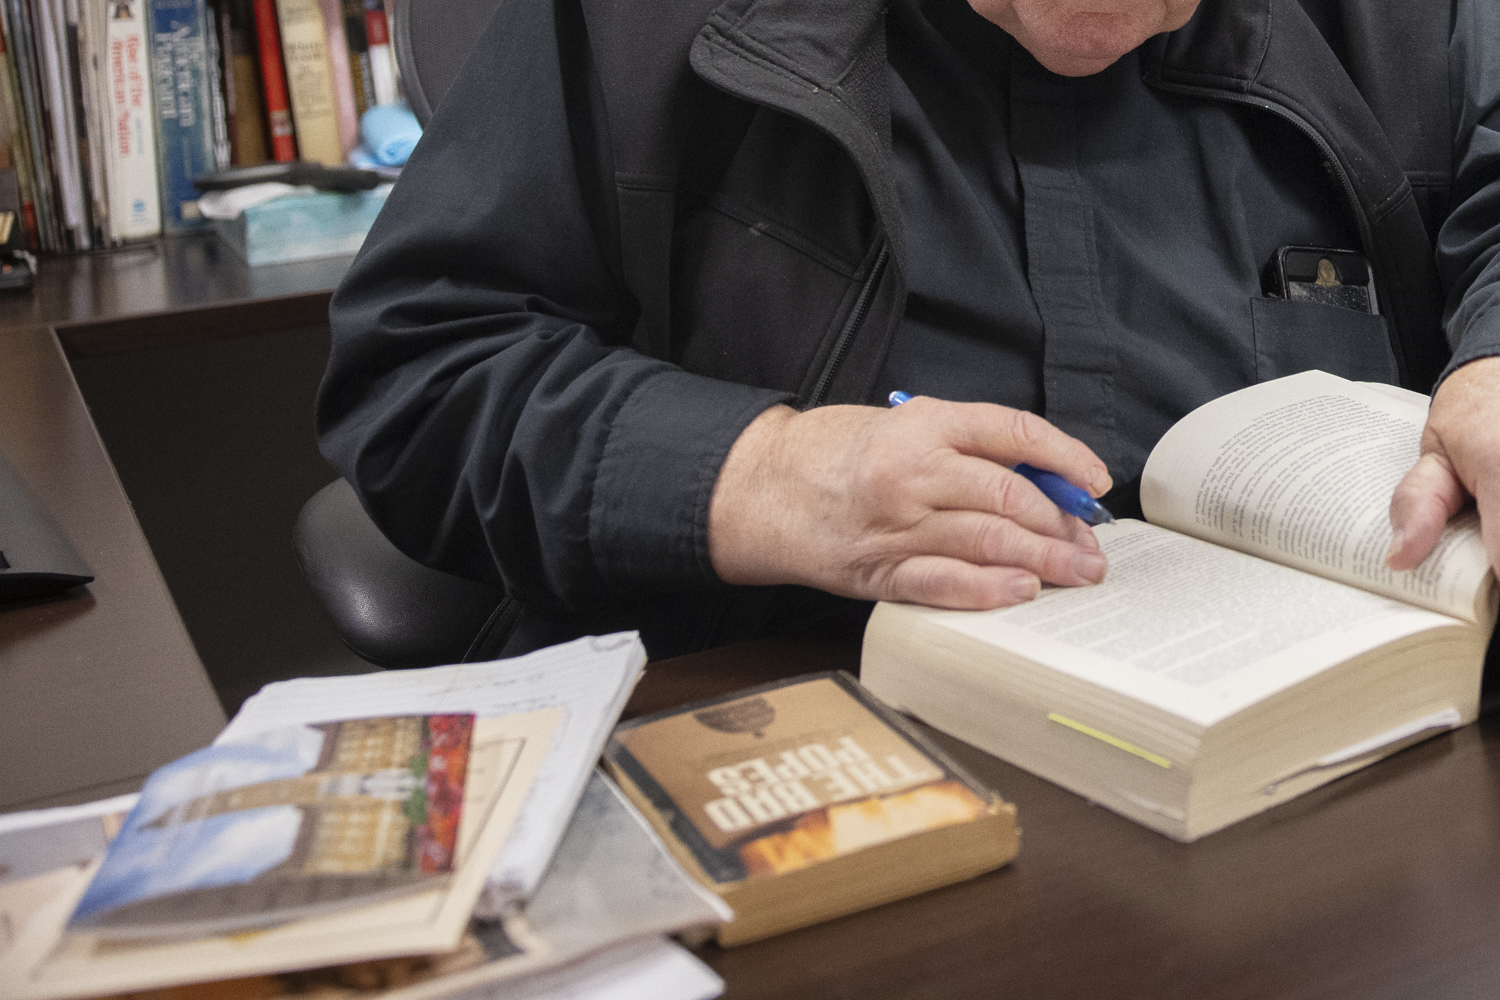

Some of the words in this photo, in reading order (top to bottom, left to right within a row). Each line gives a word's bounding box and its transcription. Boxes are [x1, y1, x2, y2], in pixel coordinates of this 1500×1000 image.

[708, 736, 870, 797] POPES
[826, 755, 946, 798] THE
[704, 782, 819, 833] BAD
